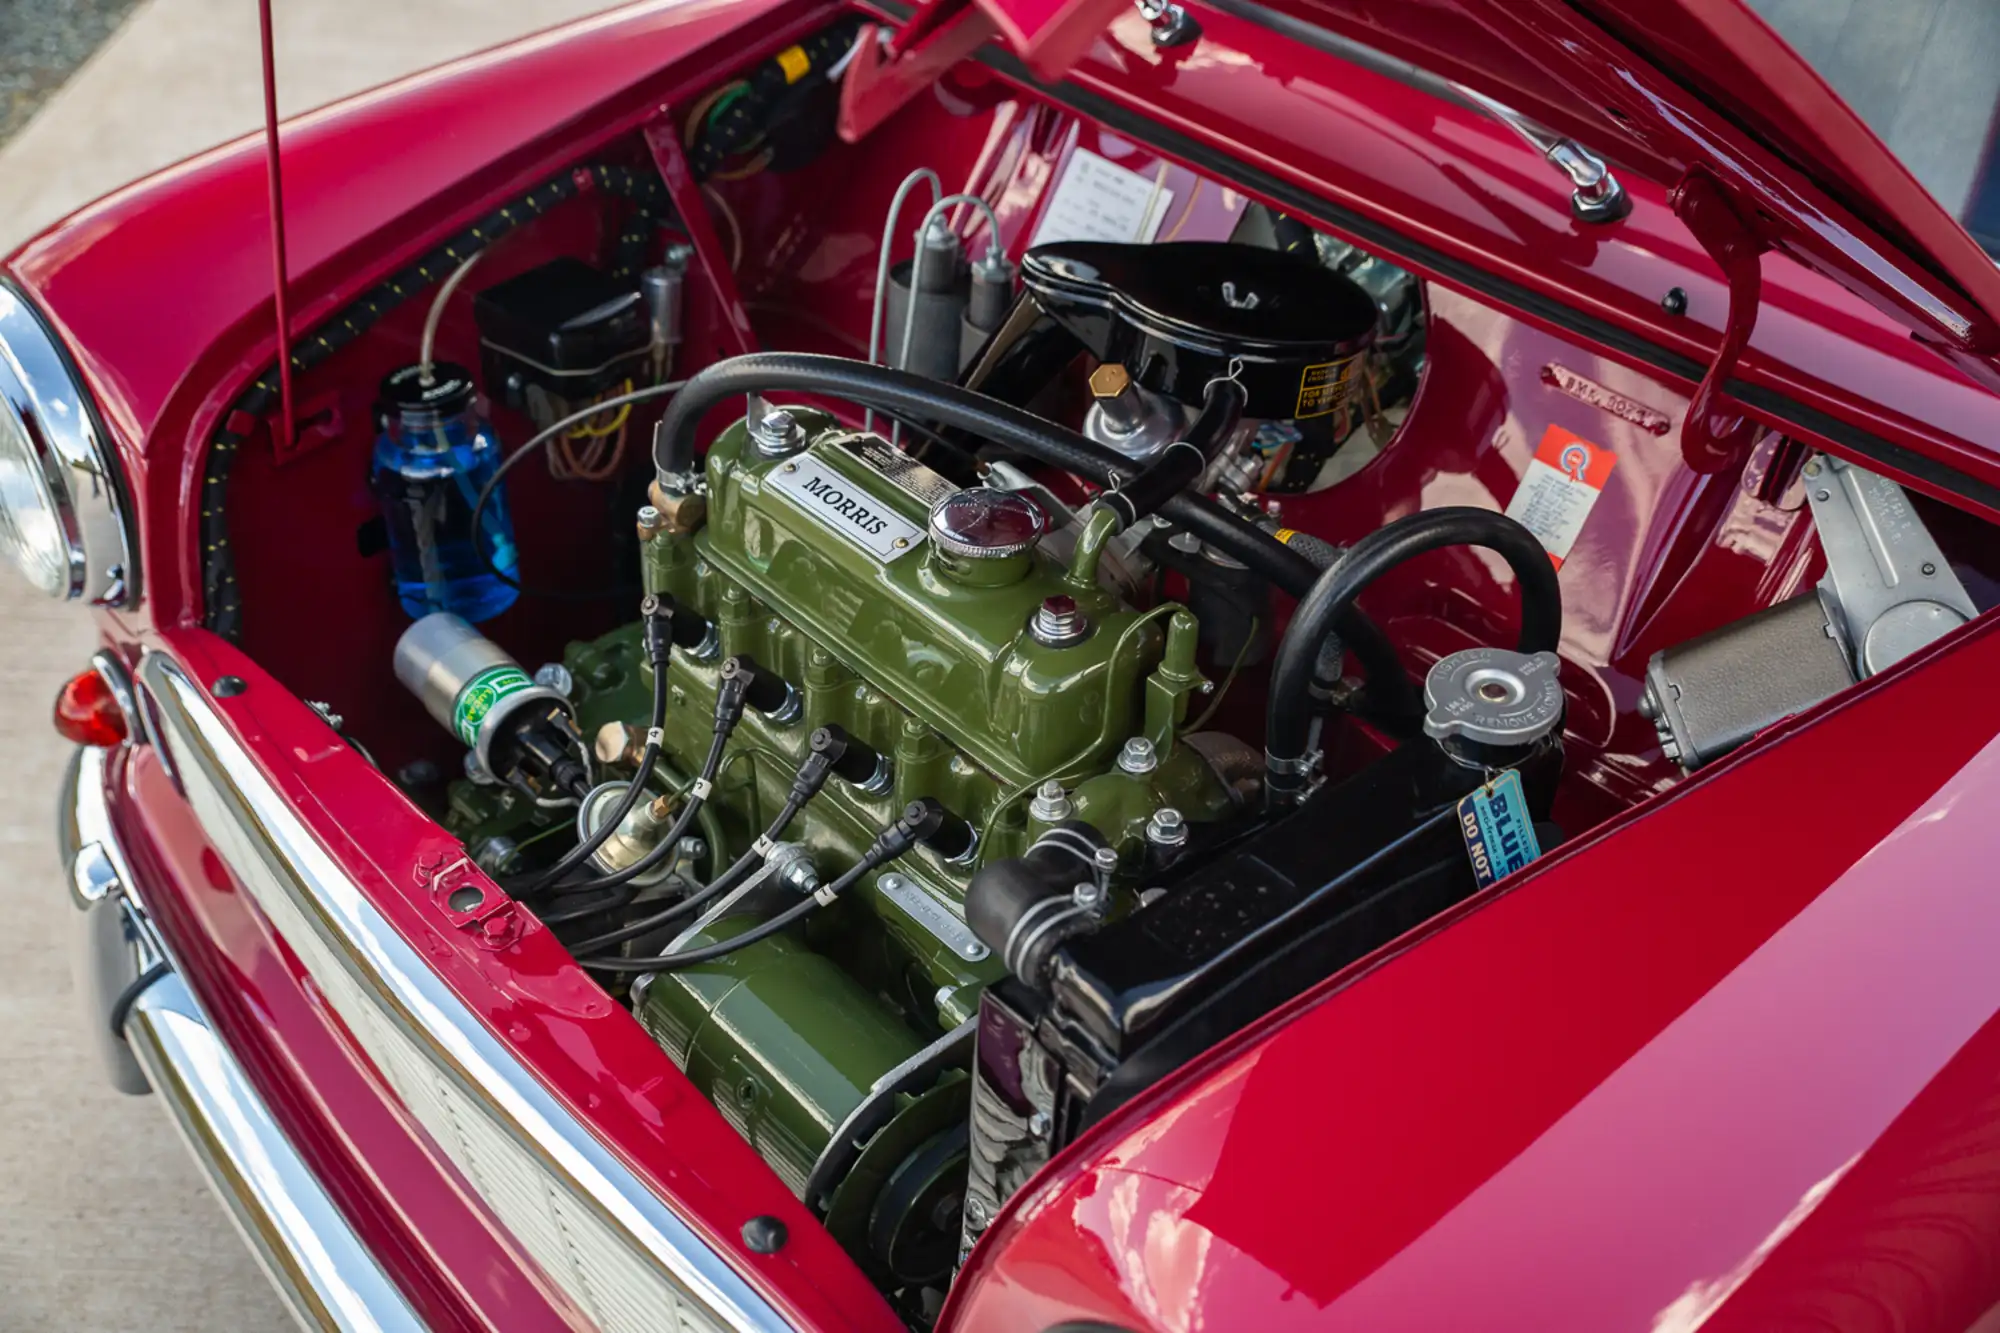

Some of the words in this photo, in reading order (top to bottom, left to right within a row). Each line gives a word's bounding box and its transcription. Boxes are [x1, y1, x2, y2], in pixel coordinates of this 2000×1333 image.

[802, 476, 889, 535] MORRIS
[1474, 711, 1538, 729] REMOVE
[649, 730, 659, 739] 4
[1463, 811, 1478, 839] DO
[1488, 793, 1525, 874] BLUE
[759, 836, 768, 848] 2
[1470, 842, 1492, 879] NOT
